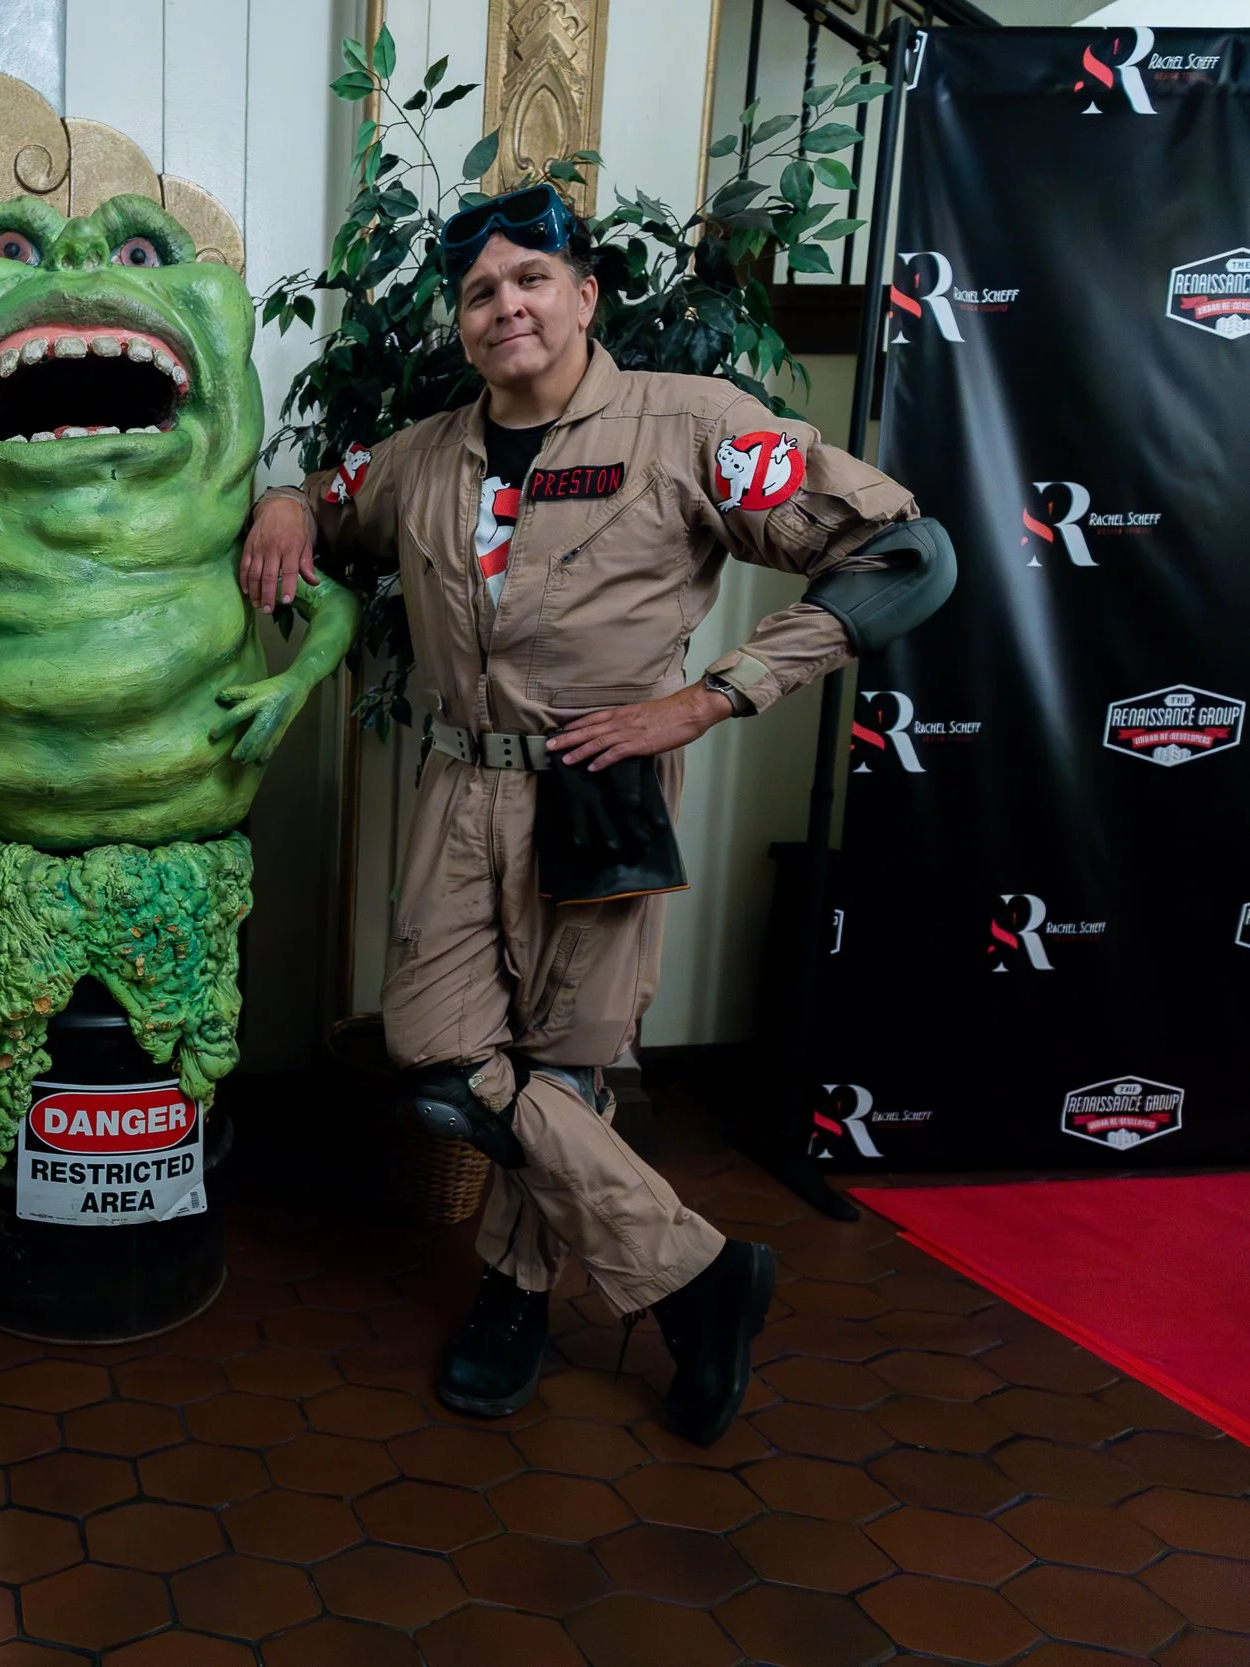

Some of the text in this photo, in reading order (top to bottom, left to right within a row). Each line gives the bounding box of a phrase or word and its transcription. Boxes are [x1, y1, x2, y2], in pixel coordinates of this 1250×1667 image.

[1174, 273, 1250, 294] RENAISSANC
[531, 467, 621, 496] PRESTON
[1112, 706, 1240, 727] RENAISSANCE GROUP
[1067, 1093, 1180, 1113] RENAISSANCE GROUP
[44, 1102, 187, 1136] DANGER
[31, 1152, 195, 1185] RESTRICTED
[80, 1189, 155, 1213] AREA
